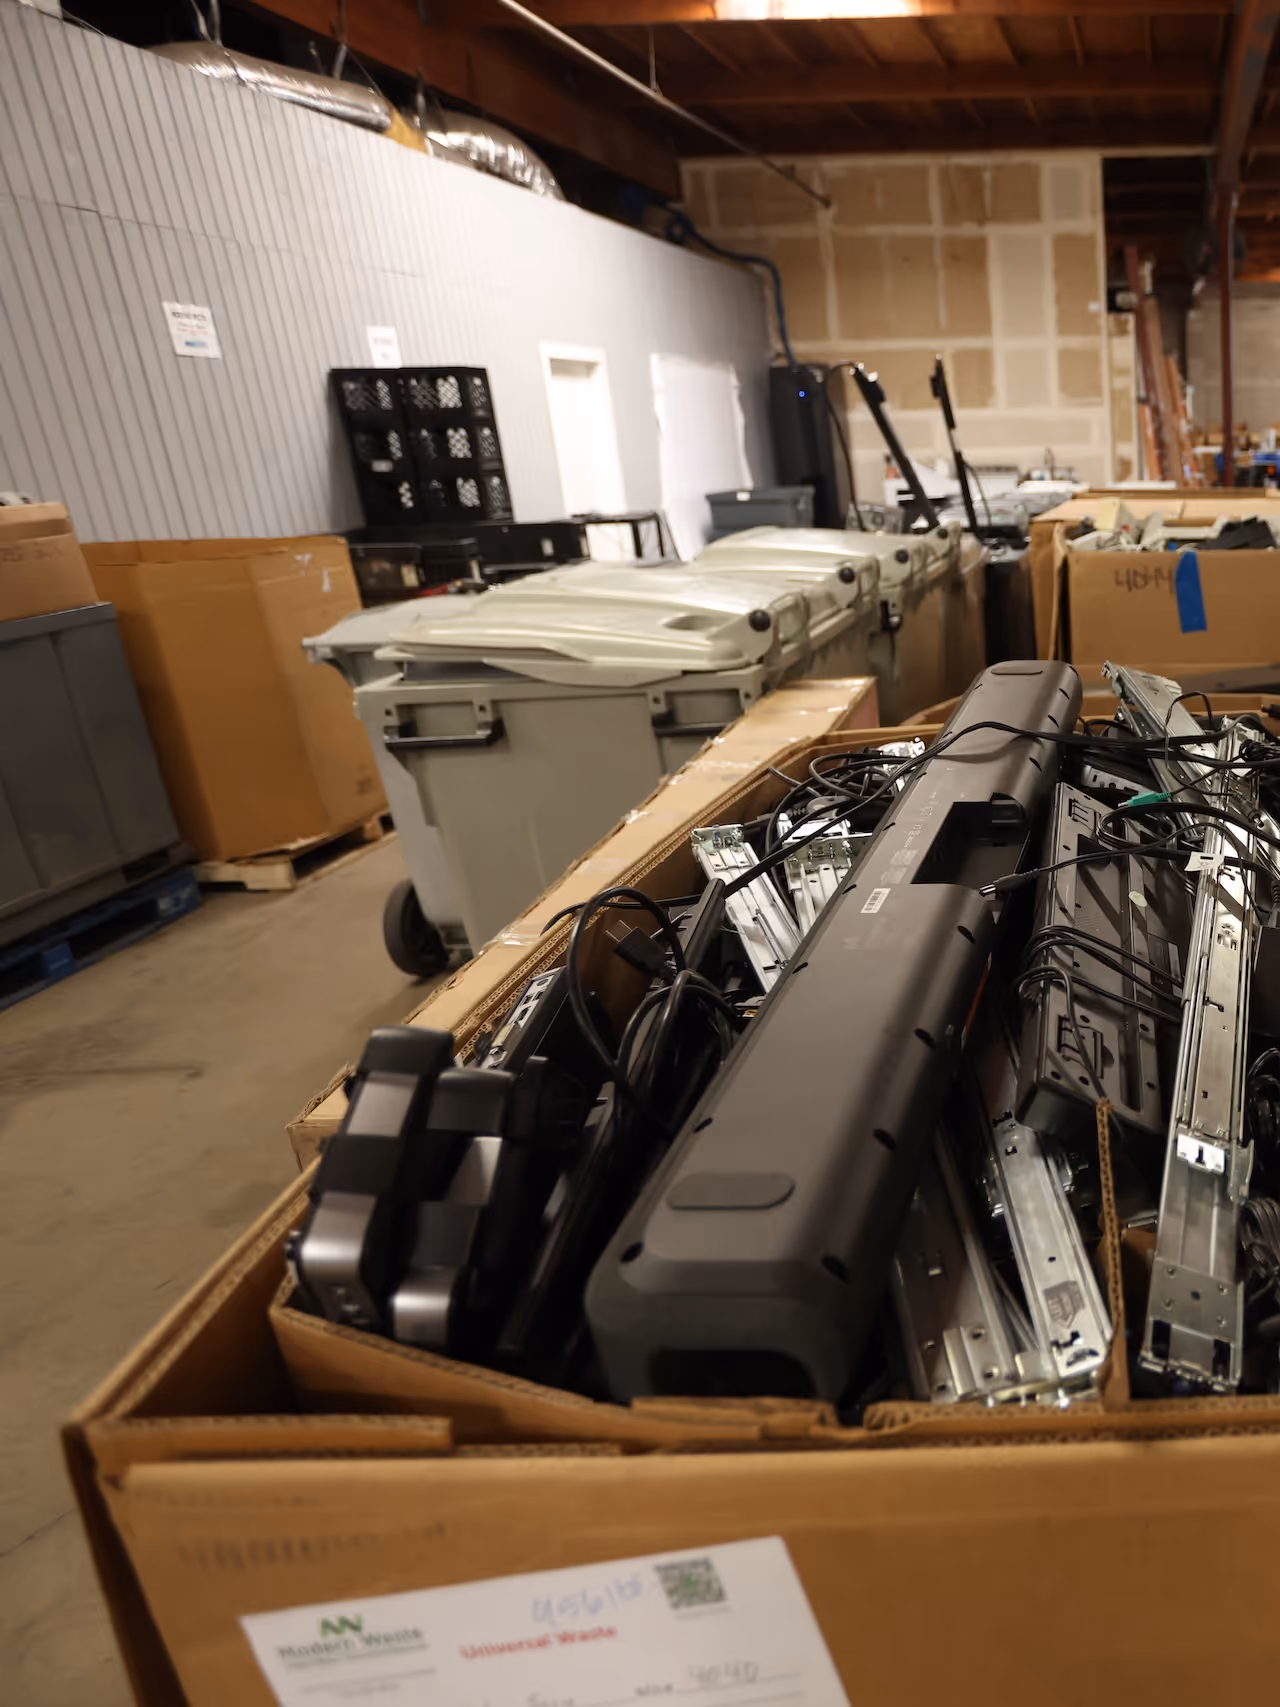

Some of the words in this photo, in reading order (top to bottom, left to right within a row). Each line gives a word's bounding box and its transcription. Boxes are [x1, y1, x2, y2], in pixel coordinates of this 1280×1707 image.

[360, 1626, 424, 1647] Waste
[459, 1632, 552, 1660] Universal
[554, 1625, 619, 1647] Waste
